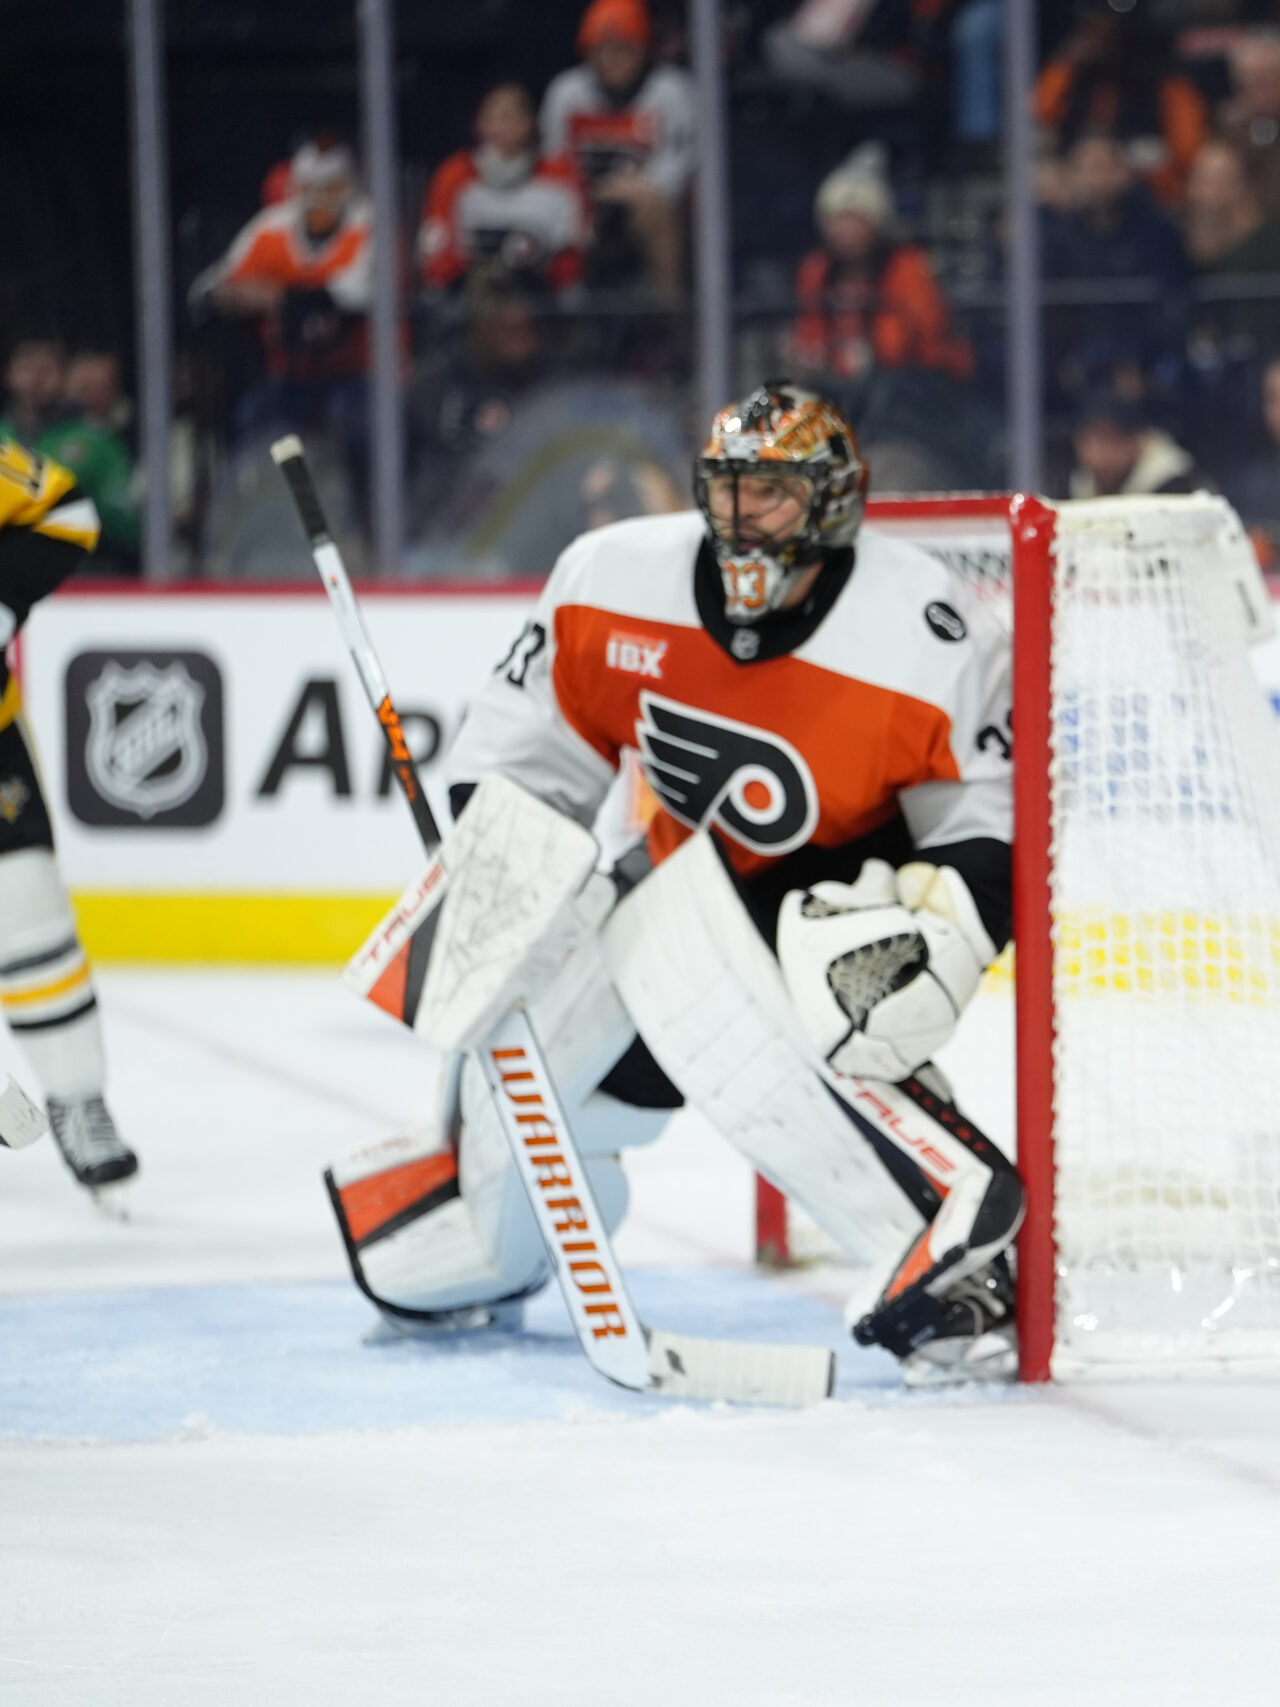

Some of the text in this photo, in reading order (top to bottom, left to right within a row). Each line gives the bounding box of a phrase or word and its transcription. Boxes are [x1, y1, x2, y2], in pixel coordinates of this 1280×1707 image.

[606, 640, 665, 679] IBX
[361, 863, 443, 967] TRUE
[491, 1048, 628, 1339] WARRIOR
